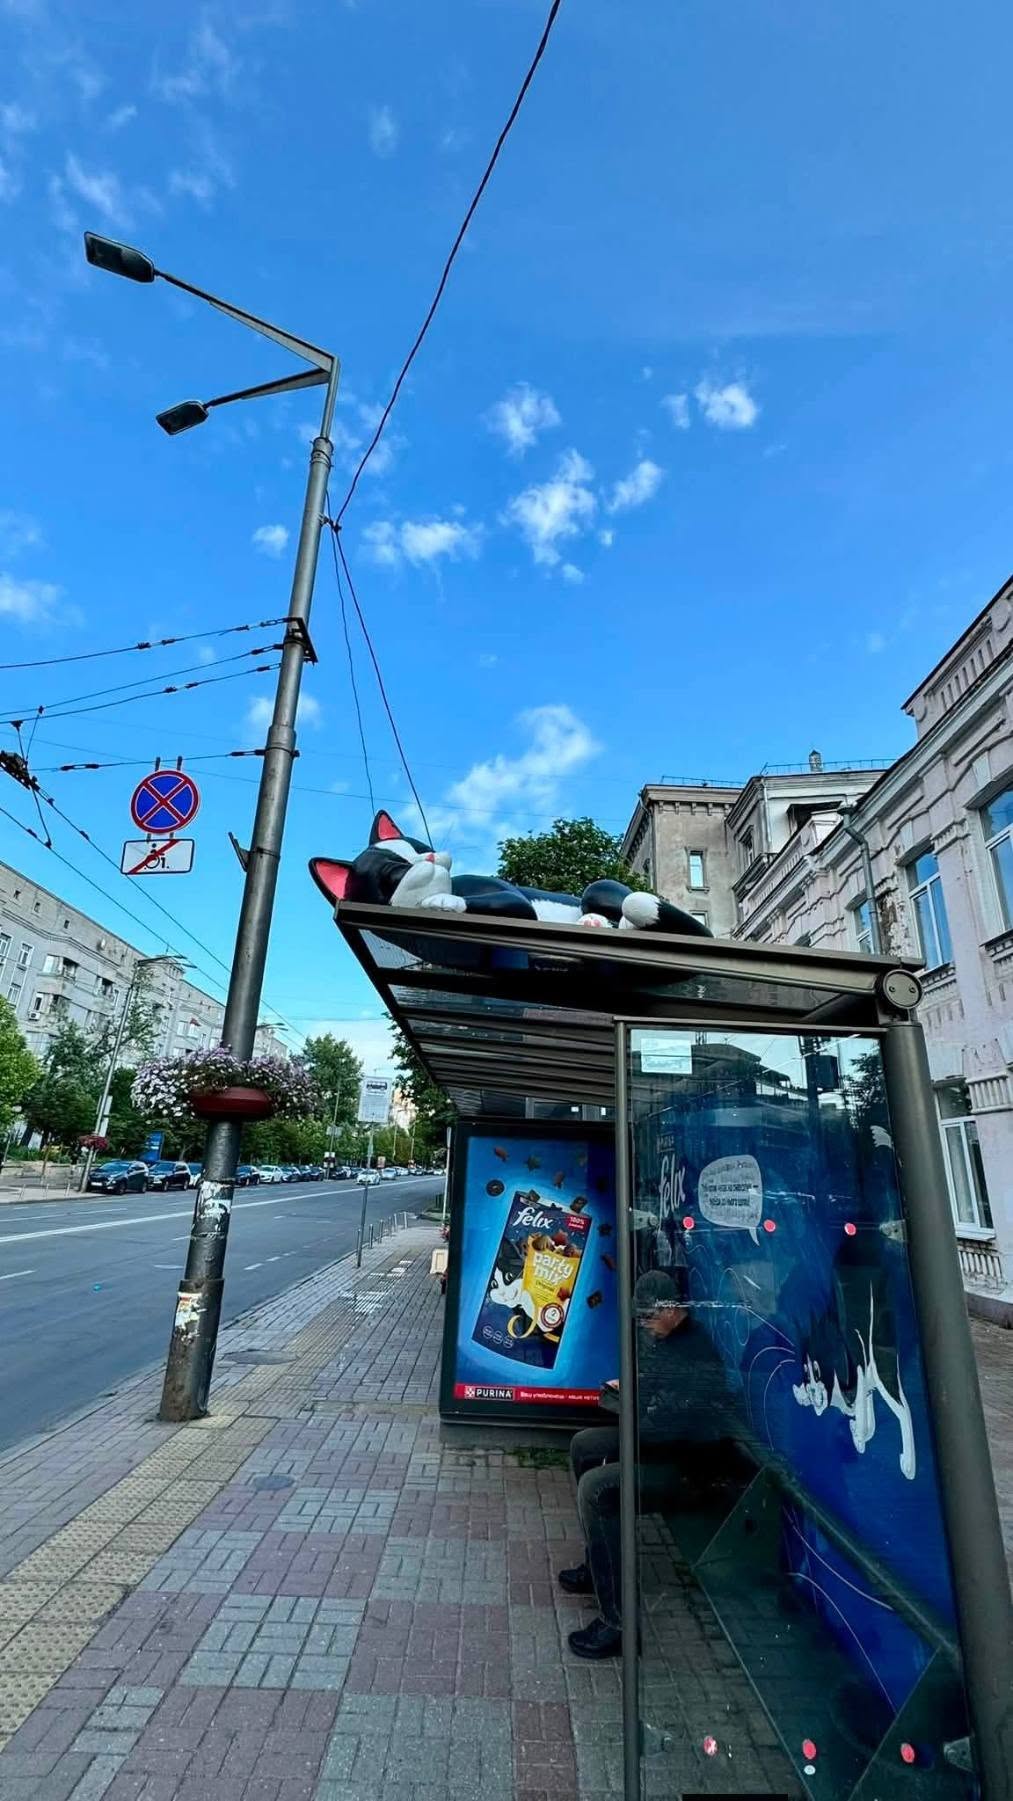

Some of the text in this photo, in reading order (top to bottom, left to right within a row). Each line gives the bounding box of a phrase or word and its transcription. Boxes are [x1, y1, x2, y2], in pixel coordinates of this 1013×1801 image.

[656, 1153, 686, 1230] felix
[512, 1206, 554, 1229] felix
[533, 1251, 574, 1279] party
[533, 1264, 562, 1285] mix
[476, 1388, 512, 1398] PURINA
